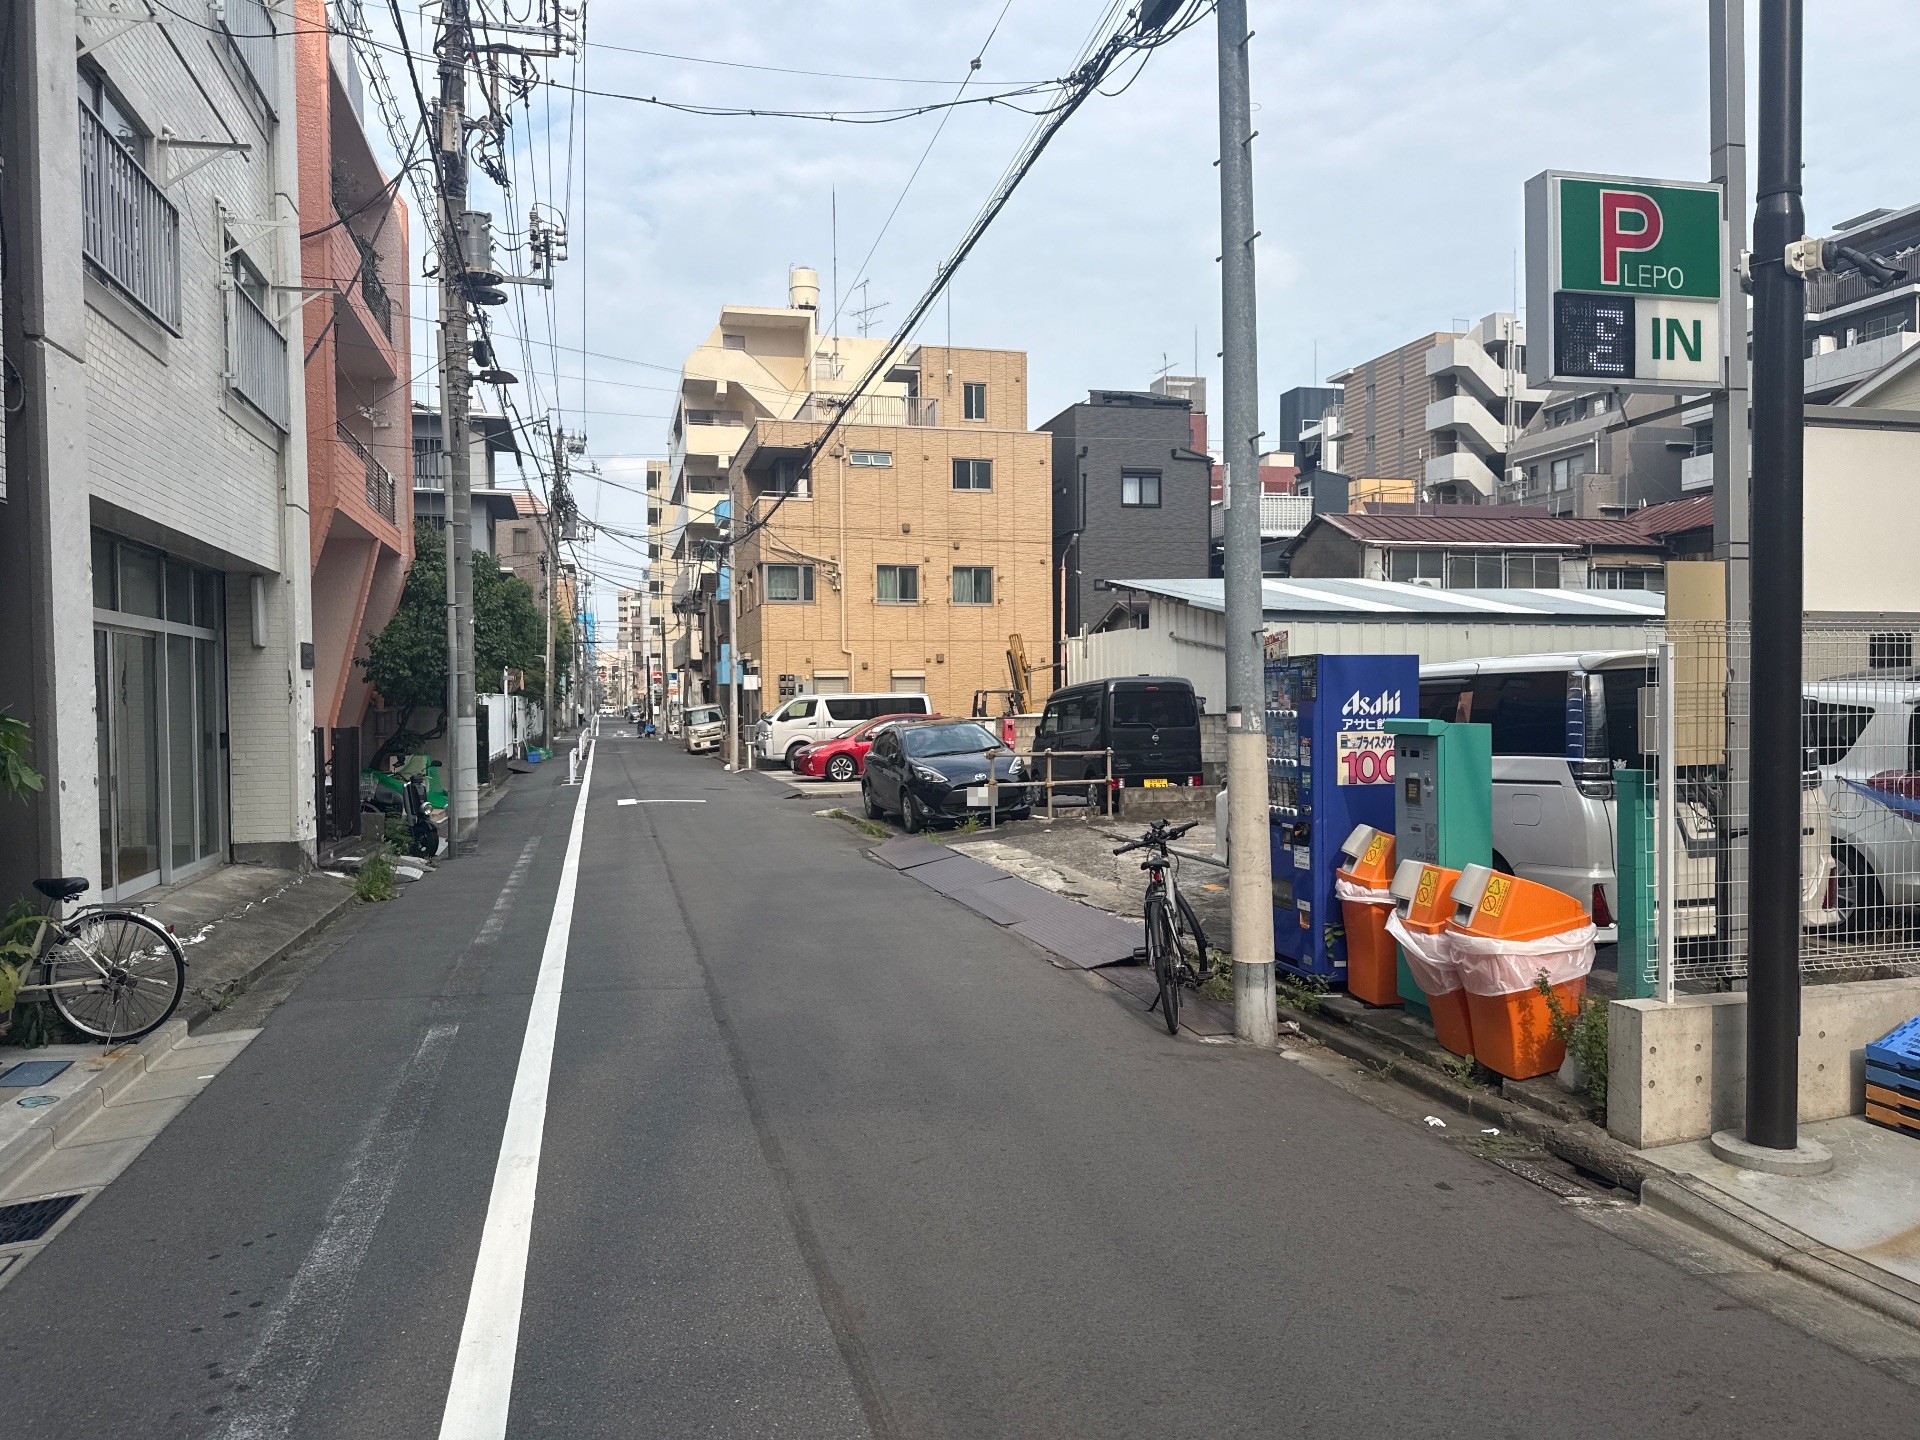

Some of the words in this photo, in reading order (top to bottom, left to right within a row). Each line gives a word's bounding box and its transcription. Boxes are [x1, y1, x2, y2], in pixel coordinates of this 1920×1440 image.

[1600, 189, 1663, 285] P
[1624, 264, 1684, 289] LEPO
[1652, 317, 1701, 361] IN
[1342, 690, 1401, 715] Asahi
[1356, 735, 1395, 750] プライスダウ
